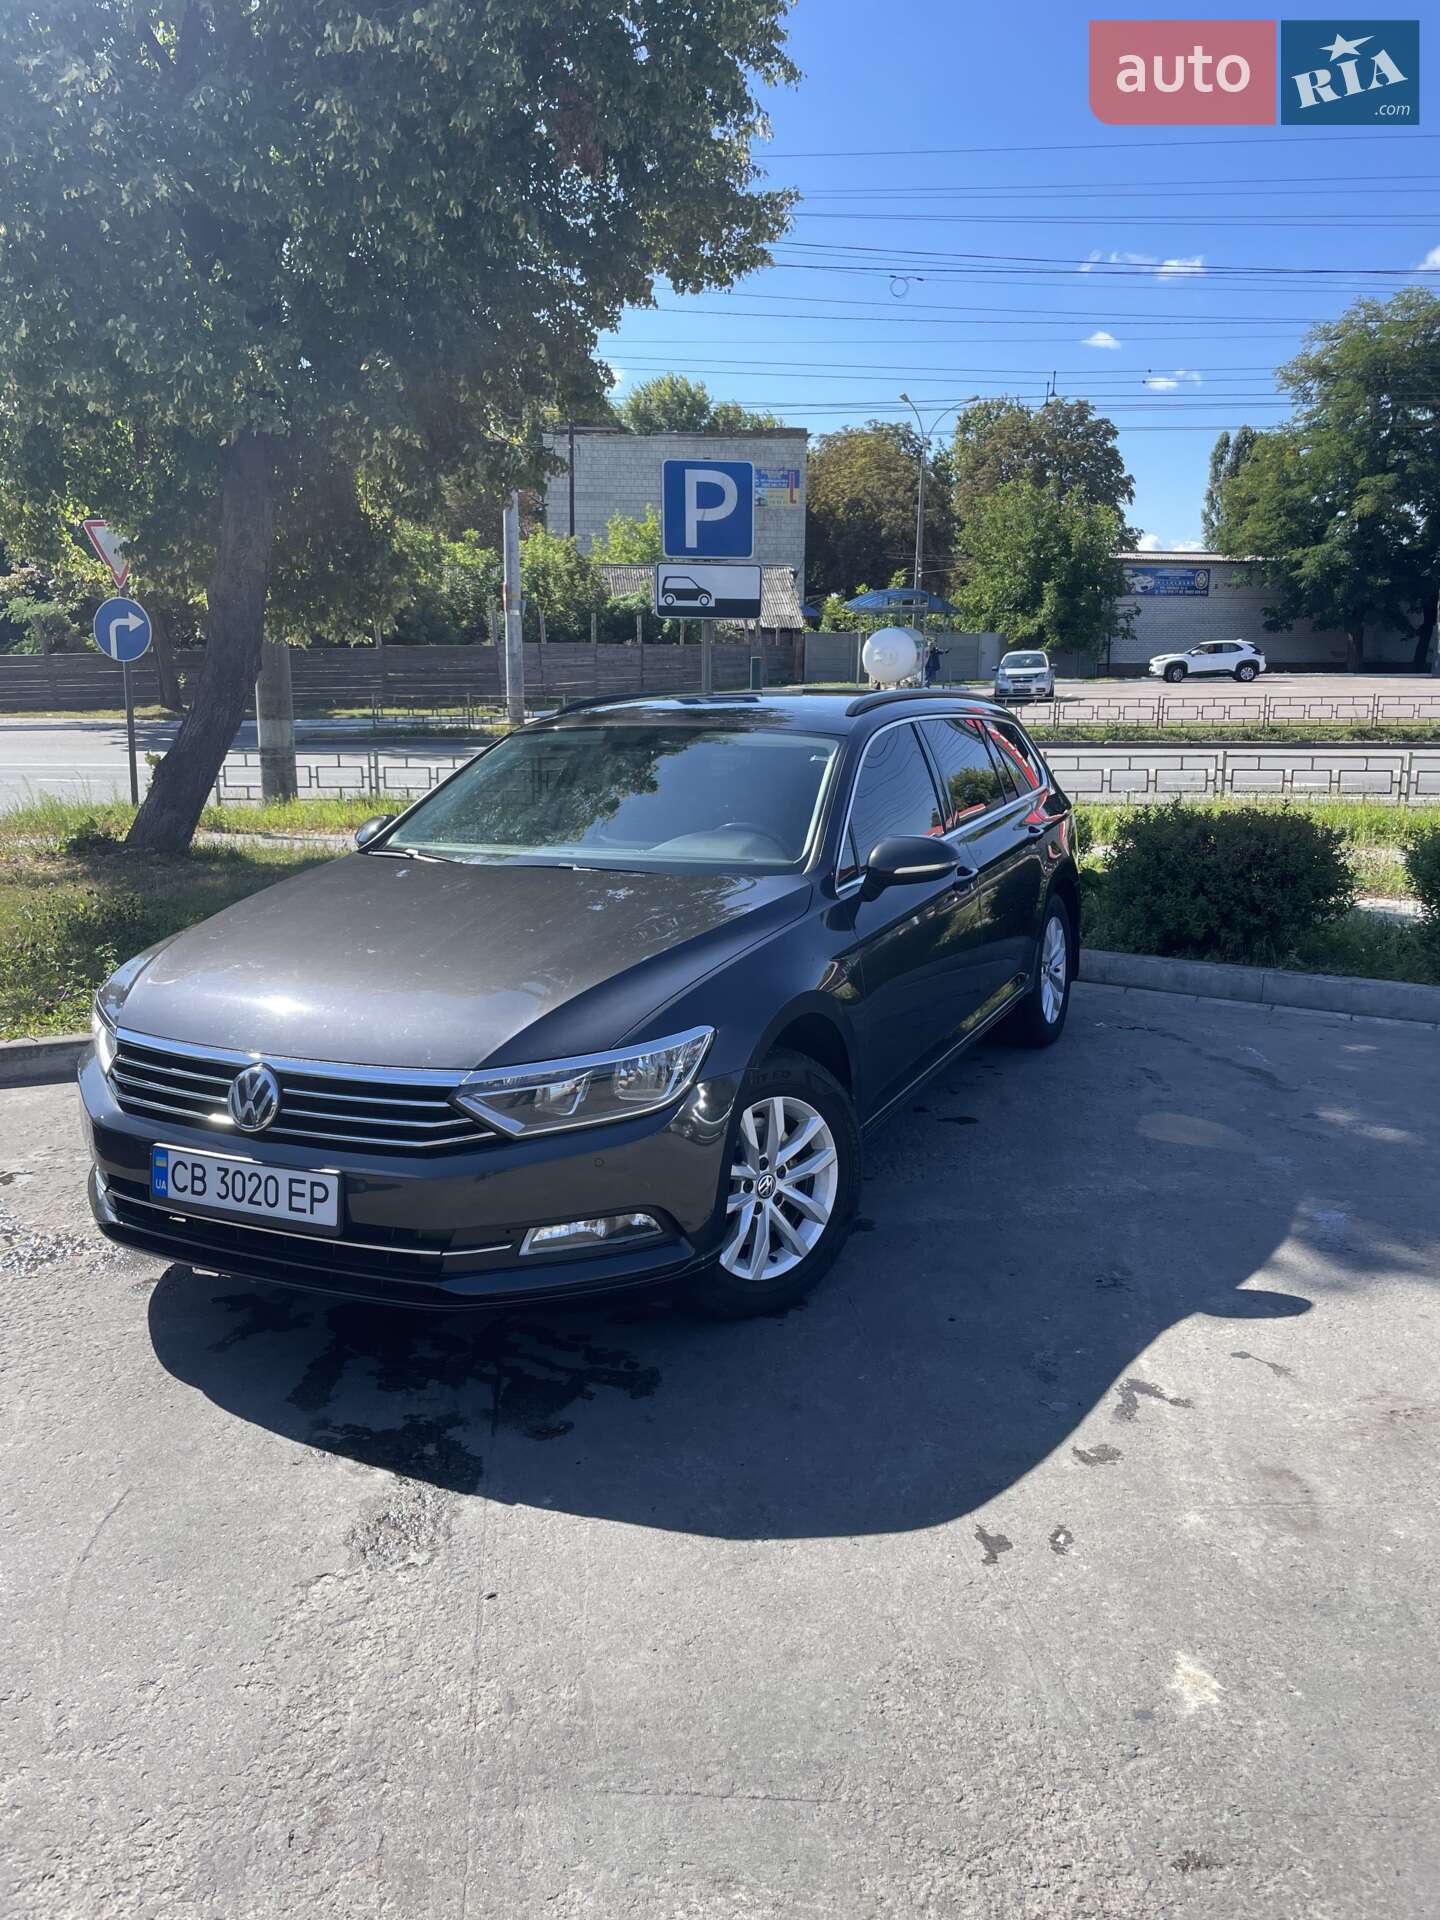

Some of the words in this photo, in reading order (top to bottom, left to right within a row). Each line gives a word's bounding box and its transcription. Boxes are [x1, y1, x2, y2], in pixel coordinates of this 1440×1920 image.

[685, 469, 738, 548] P
[231, 1066, 277, 1129] VW
[155, 1178, 167, 1190] UA
[171, 1160, 207, 1196] CB
[216, 1167, 279, 1208] 3020
[288, 1177, 329, 1214] EP
